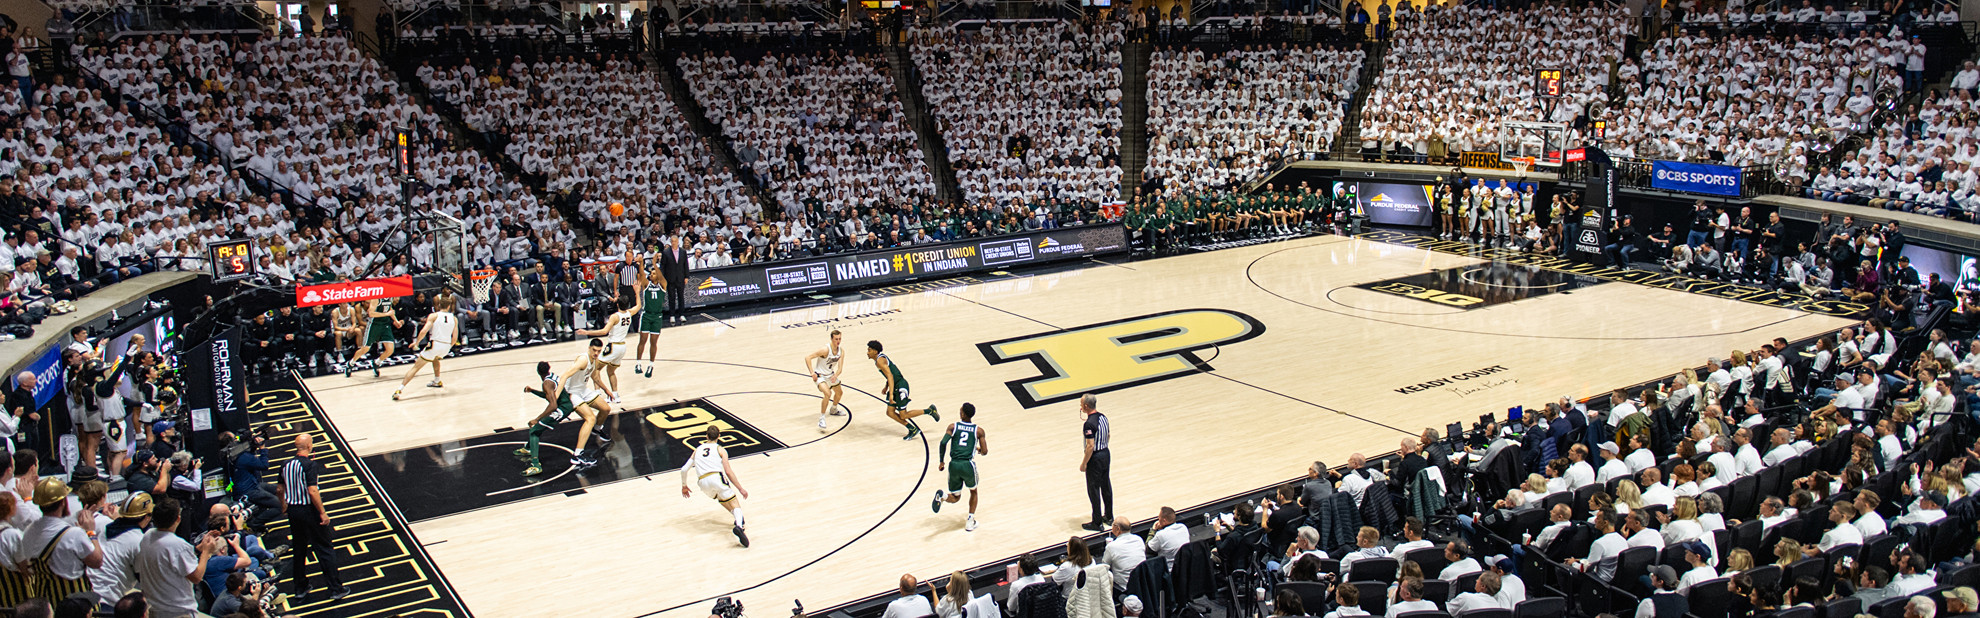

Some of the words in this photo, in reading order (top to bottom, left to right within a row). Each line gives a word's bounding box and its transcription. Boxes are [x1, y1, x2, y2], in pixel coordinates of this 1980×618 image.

[1540, 71, 1560, 80] 19:10
[1548, 79, 1559, 95] 5
[1666, 170, 1688, 182] CBS
[1690, 172, 1736, 187] SPORTS
[1349, 184, 1356, 194] 0
[218, 243, 248, 259] 19:10
[911, 249, 944, 264] CREDIT
[946, 245, 976, 259] UNION
[1038, 246, 1061, 254] PURDUE
[1061, 243, 1084, 251] FEDERAL
[1575, 243, 1600, 253] PIONEER
[231, 256, 245, 273] 5
[836, 257, 891, 281] NAMED
[892, 252, 915, 275] #1
[923, 261, 934, 273] IN
[934, 257, 968, 271] INDIANA
[698, 287, 728, 297] PURDUE
[728, 283, 760, 293] FEDERAL
[443, 316, 449, 324] 1
[620, 316, 631, 327] 25
[780, 317, 840, 330] KEADY
[844, 308, 902, 320] COURT
[976, 308, 1267, 409] P
[211, 342, 221, 387] AUTOMOTIVE
[216, 388, 224, 413] GROUP
[216, 339, 237, 412] ROHRMAN
[1393, 376, 1454, 395] KEADY
[1452, 364, 1509, 381] COURT
[957, 424, 975, 432] WALKER
[958, 432, 969, 447] 2
[702, 447, 711, 458] 3
